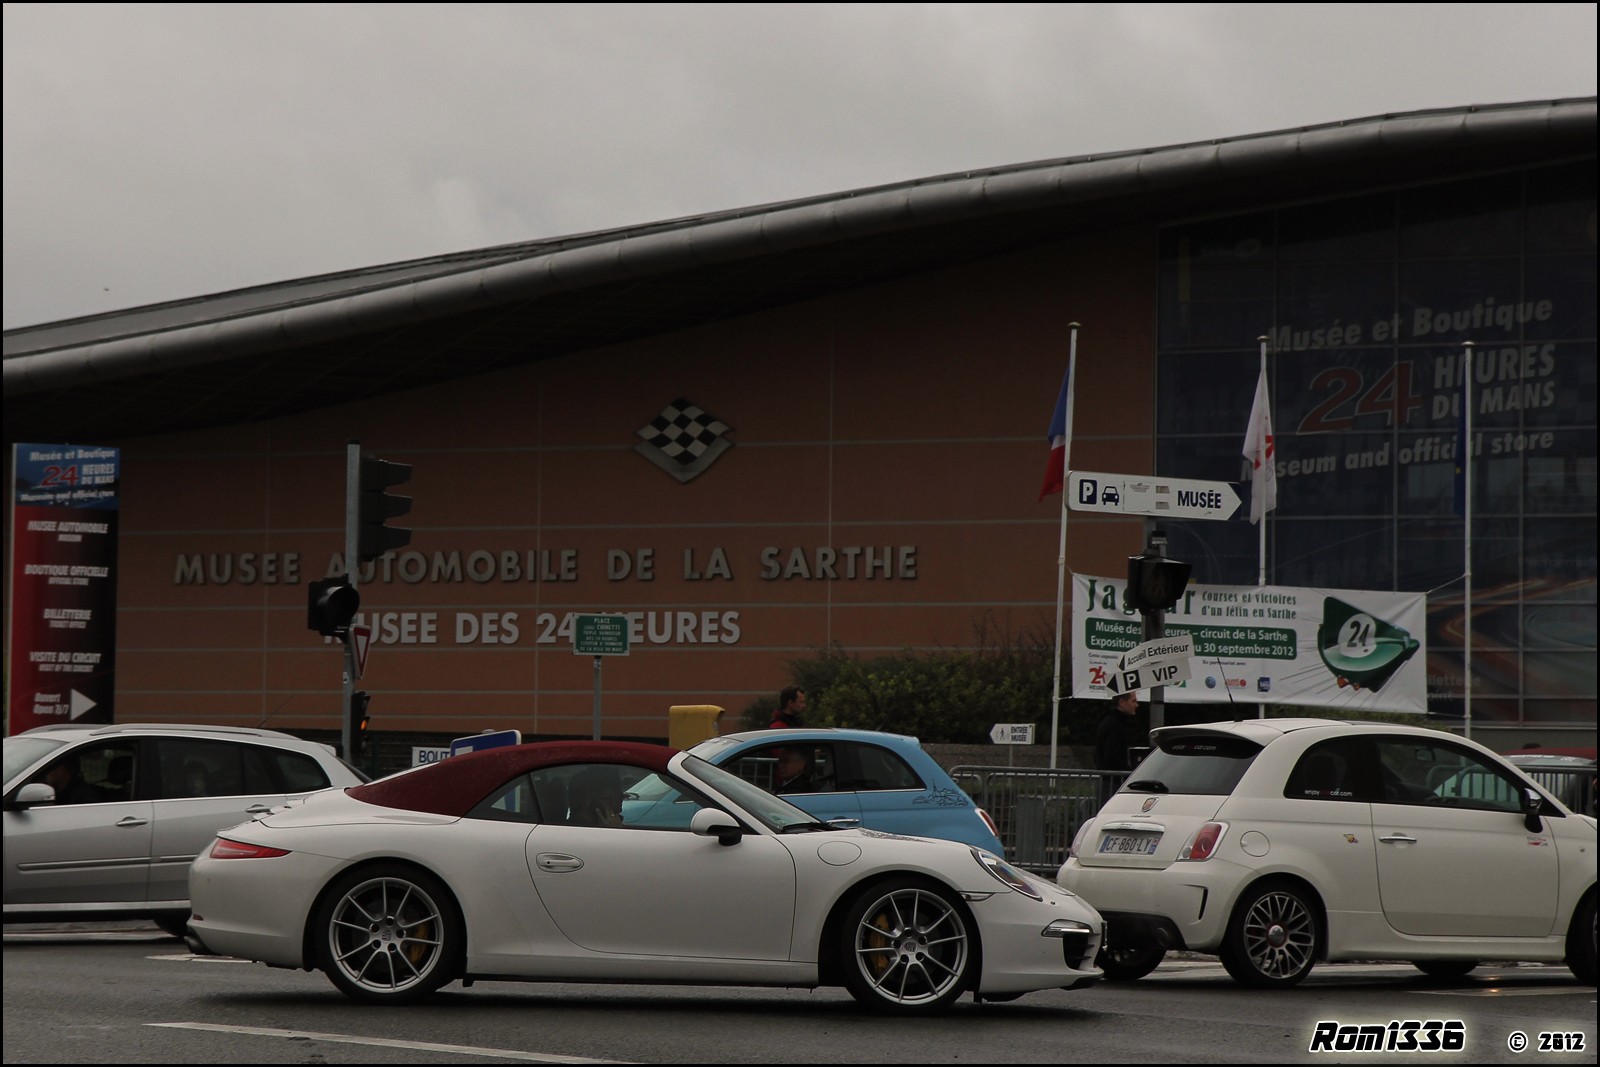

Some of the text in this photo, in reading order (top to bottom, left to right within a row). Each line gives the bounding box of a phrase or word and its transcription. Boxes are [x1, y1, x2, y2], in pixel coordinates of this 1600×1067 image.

[1266, 297, 1553, 353] Musée et Boutique
[1296, 360, 1423, 435] 24
[1480, 381, 1555, 414] MANS
[77, 448, 116, 459] Boutique
[1345, 440, 1389, 470] and
[1399, 432, 1483, 464] officil
[1491, 432, 1554, 454] store
[40, 465, 79, 487] 24
[1177, 490, 1221, 509] MUSÉE
[57, 521, 109, 534] AUTOMOBILE
[24, 564, 109, 577] BOUTIQUE OFFICIELLE
[174, 545, 918, 585] MUSEE AUTOMOBILE DE LA SARTHE
[1202, 591, 1238, 603] Courses
[1242, 593, 1251, 603] et
[1255, 593, 1297, 605] victoires
[43, 608, 92, 620] BILLETTERIE
[1202, 605, 1297, 619] d'un félin en Sarthe
[325, 611, 438, 644] USEE
[455, 611, 520, 644] DES
[602, 611, 741, 645] EURES
[1095, 621, 1124, 633] Musée
[1126, 624, 1142, 635] des
[1165, 627, 1191, 637] eures
[1200, 628, 1231, 639] circuit
[1232, 629, 1245, 640] de
[1247, 630, 1256, 640] la
[1258, 630, 1288, 641] Sarthe
[1346, 620, 1369, 648] 24
[1090, 635, 1137, 648] Exposition
[1203, 643, 1216, 653] 30
[1218, 643, 1270, 655] septembre
[1272, 645, 1294, 656] 2012
[1127, 644, 1189, 666] Accueil Extérieur
[29, 652, 102, 664] VISITE DU CIRCUIT
[1152, 665, 1178, 682] VIP
